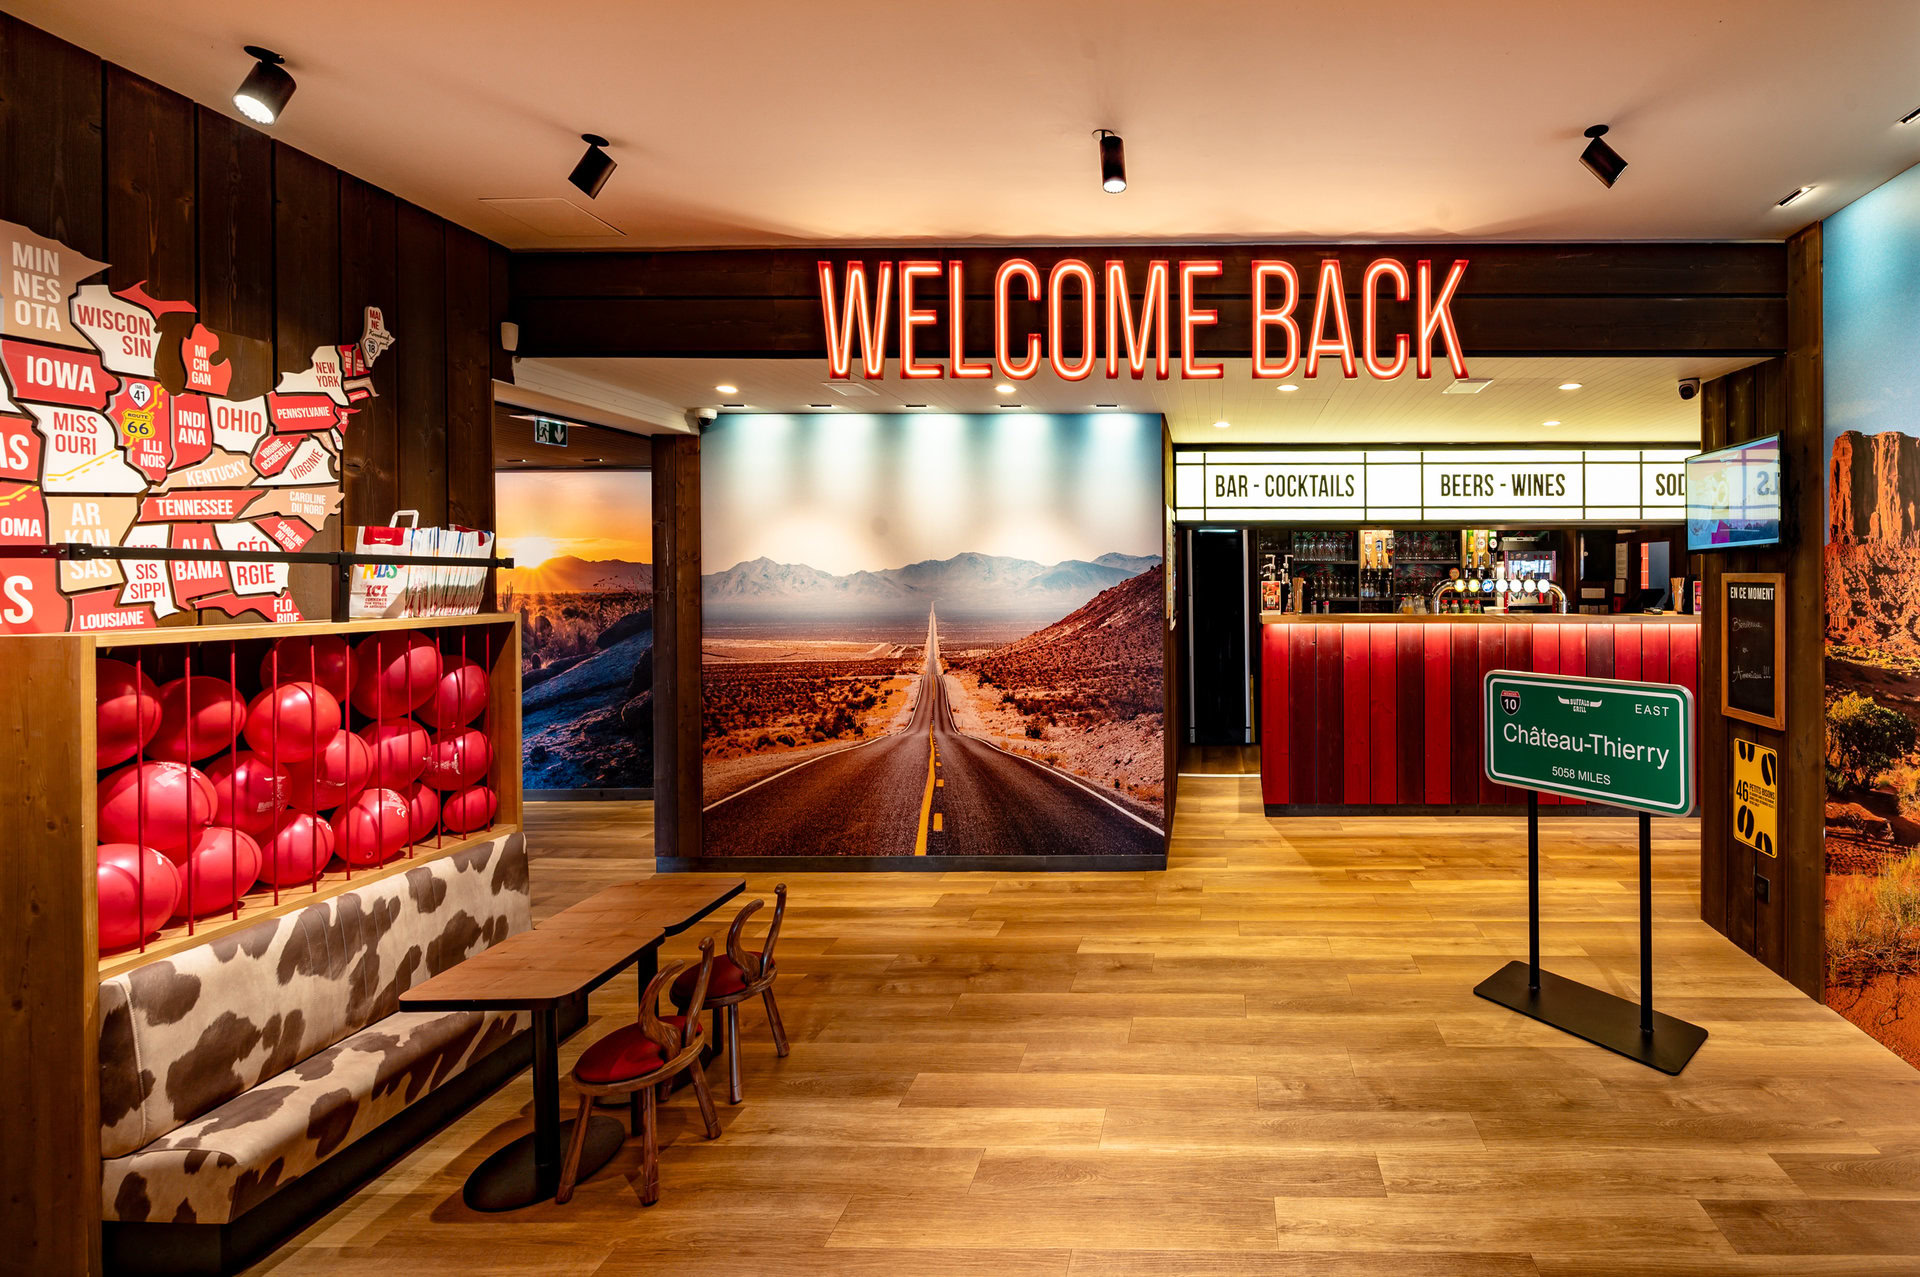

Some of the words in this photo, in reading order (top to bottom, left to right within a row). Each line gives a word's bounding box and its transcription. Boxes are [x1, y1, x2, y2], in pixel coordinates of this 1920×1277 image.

[12, 241, 60, 276] MIN
[13, 270, 61, 304] NES
[15, 300, 61, 332] OTA
[77, 304, 151, 337] WISCON
[817, 258, 1223, 381] WELCOME
[1251, 256, 1470, 381] BACK
[122, 335, 152, 358] SIN
[194, 345, 207, 358] MI
[27, 355, 96, 394] IOWA
[193, 358, 209, 372] CHI
[315, 361, 336, 375] NEW
[191, 371, 211, 386] GAN
[316, 375, 340, 388] YORK
[133, 390, 145, 401] 41
[127, 412, 148, 420] ROUTE
[178, 410, 206, 429] INDI
[217, 406, 262, 435] OHIO
[276, 406, 331, 419] PENNSYLVANIE
[53, 411, 98, 435] MISS
[127, 421, 149, 435] 66
[54, 434, 97, 456] OURI
[178, 427, 206, 446] ANA
[143, 439, 163, 454] ILLI
[259, 438, 285, 459] VIRGINIE
[260, 441, 295, 471] OCCIDENTALE
[140, 453, 166, 469] NOIS
[289, 448, 324, 480] VIRGINIE
[186, 460, 248, 486] KENTUCKY
[1215, 474, 1248, 498] BAR
[1265, 474, 1355, 498] COCKTAILS
[1441, 473, 1494, 497] BEERS
[1511, 473, 1566, 497] WINES
[156, 499, 233, 516] TENNESSEE
[289, 491, 326, 505] CAROLINE
[71, 502, 101, 526] AR
[291, 502, 302, 513] DU
[303, 504, 324, 516] NORD
[0, 517, 42, 537] OMA
[277, 521, 305, 547] CAROLINE
[274, 529, 286, 541] DU
[282, 536, 296, 550] SUD
[70, 559, 112, 580] SAS
[135, 563, 158, 580] SIS
[175, 560, 223, 581] BAMA
[236, 563, 276, 587] RGIE
[130, 581, 166, 600] SIPPI
[365, 584, 388, 597] ICI
[1730, 586, 1738, 599] EN
[1739, 586, 1747, 599] CE
[1747, 587, 1774, 601] MOMENT
[273, 599, 293, 613] FLO
[80, 611, 144, 630] LOUISIANE
[1504, 698, 1517, 710] 10
[1635, 704, 1670, 717] EAST
[1503, 723, 1670, 770] Château-Thierry
[1552, 766, 1575, 779] 5058
[1578, 770, 1611, 785] MILES
[1736, 779, 1749, 802] 46
